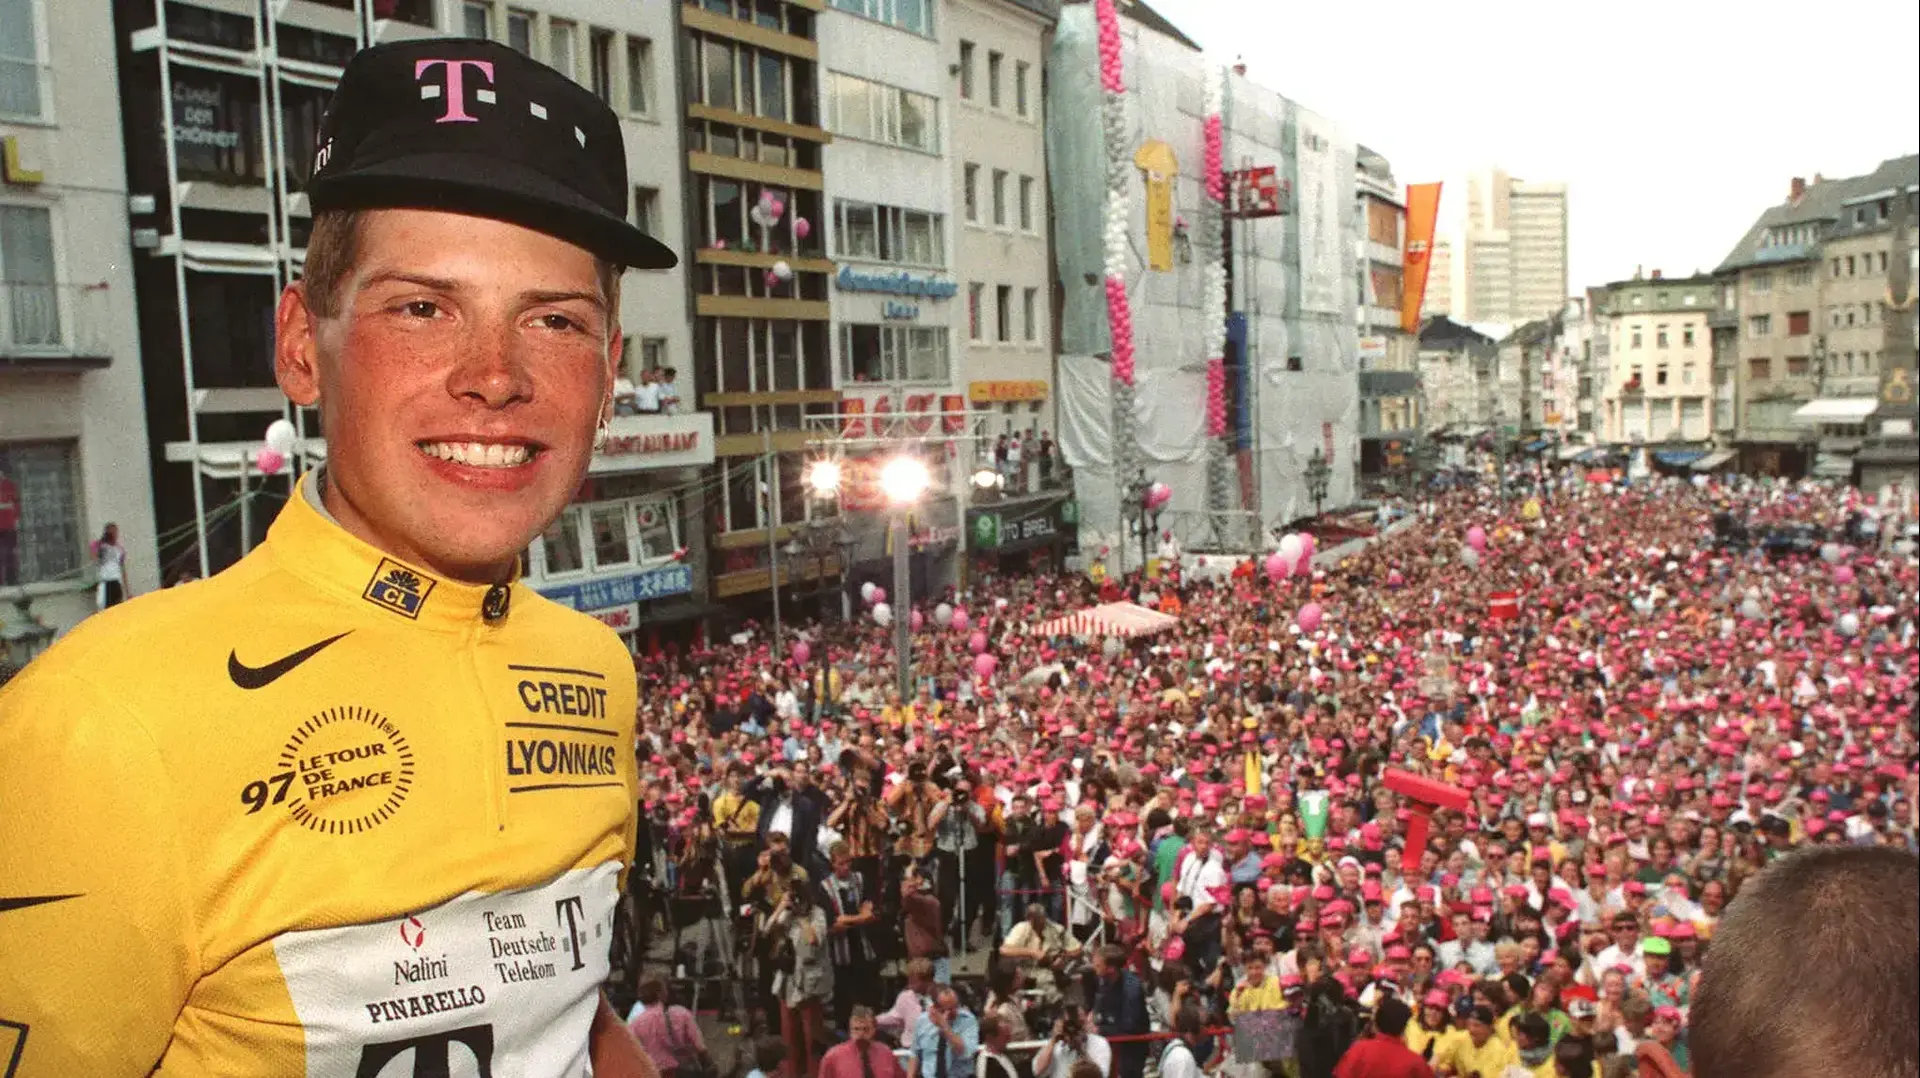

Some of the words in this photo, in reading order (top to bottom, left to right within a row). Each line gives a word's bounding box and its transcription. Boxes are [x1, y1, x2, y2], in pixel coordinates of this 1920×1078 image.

[383, 588, 408, 608] CL
[518, 680, 607, 718] CREDIT
[299, 755, 324, 772] LE
[324, 743, 387, 765] TOUR
[506, 740, 616, 775] LYONNAIS
[302, 769, 335, 785] DE
[308, 771, 392, 800] FRANCE
[241, 771, 296, 815] 97
[483, 911, 527, 932] Team
[489, 931, 556, 959] Deutsche
[394, 954, 449, 985] Nalini
[494, 960, 557, 985] Telekom
[366, 985, 487, 1023] PINARELLO
